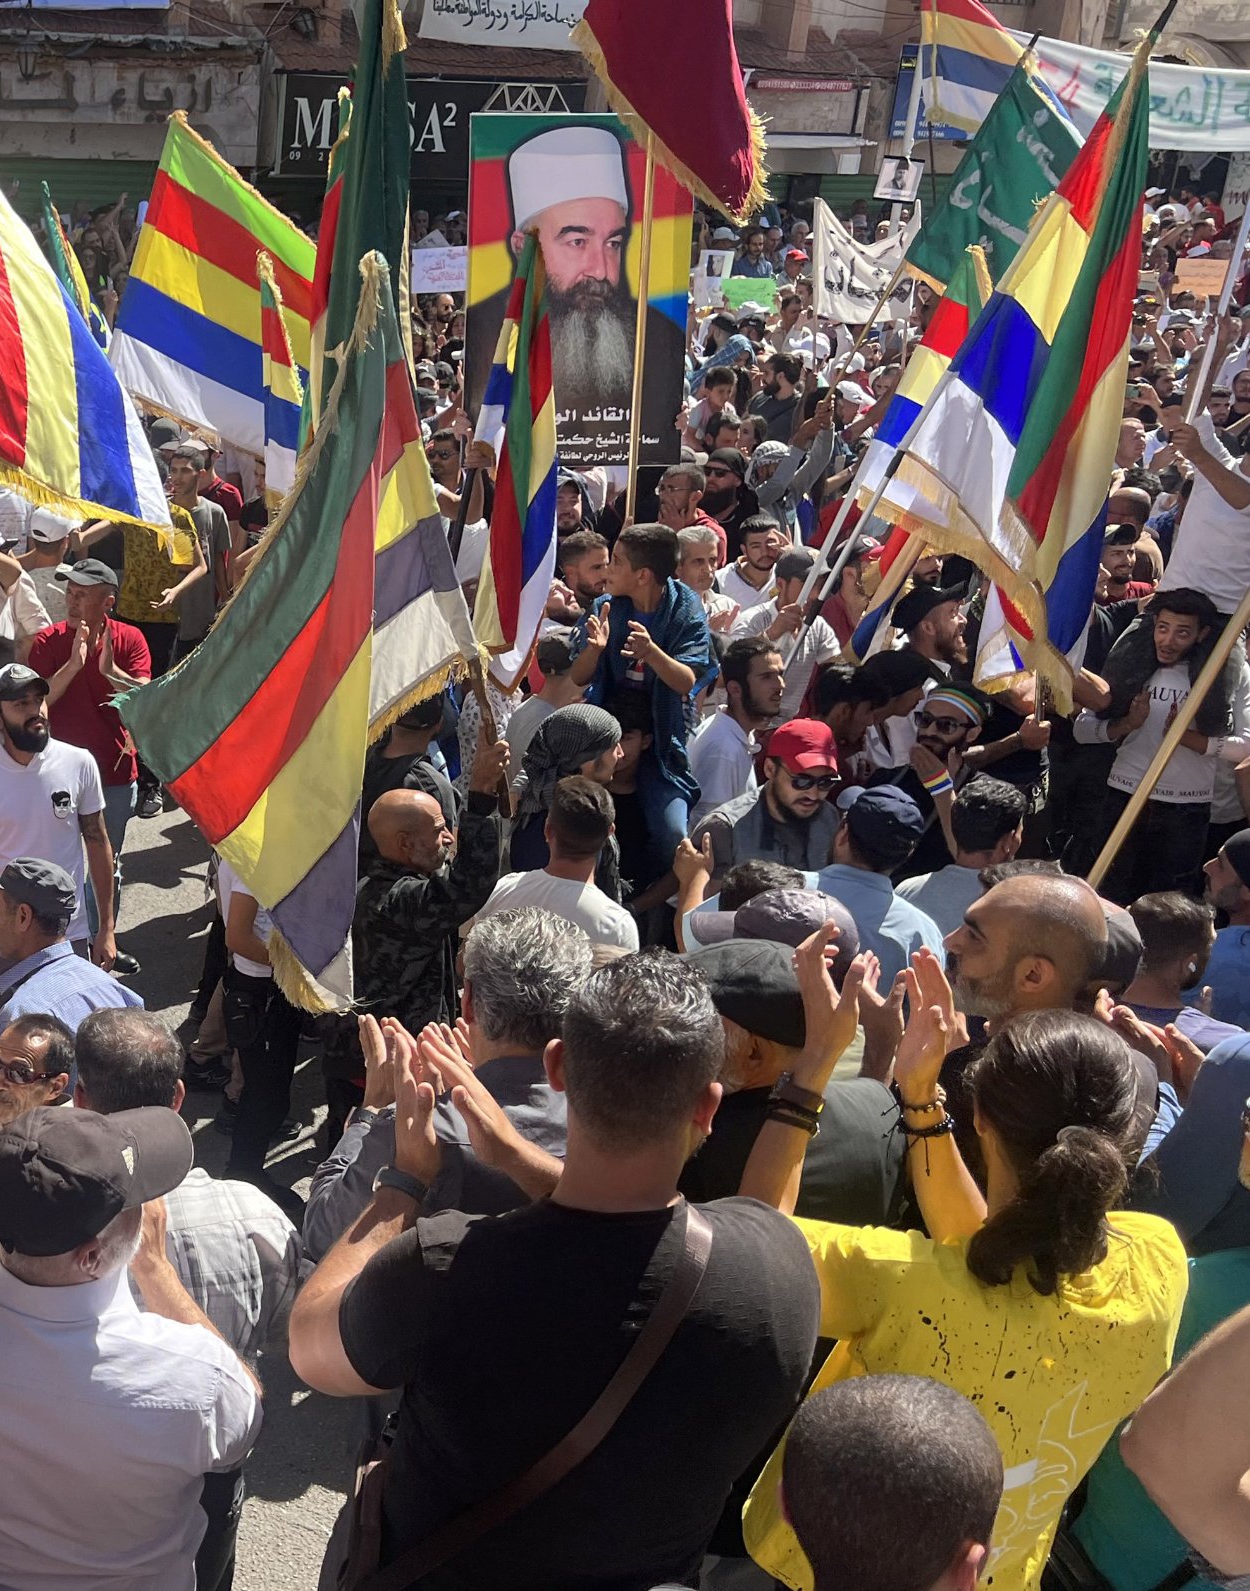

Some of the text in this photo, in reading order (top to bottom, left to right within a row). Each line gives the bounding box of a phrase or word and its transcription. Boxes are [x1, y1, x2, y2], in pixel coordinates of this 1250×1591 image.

[582, 405, 631, 422] القائد
[556, 433, 594, 445] حكمت
[595, 431, 624, 448] الشيخ
[583, 451, 607, 462] الروحي
[608, 450, 630, 461] لرئيس
